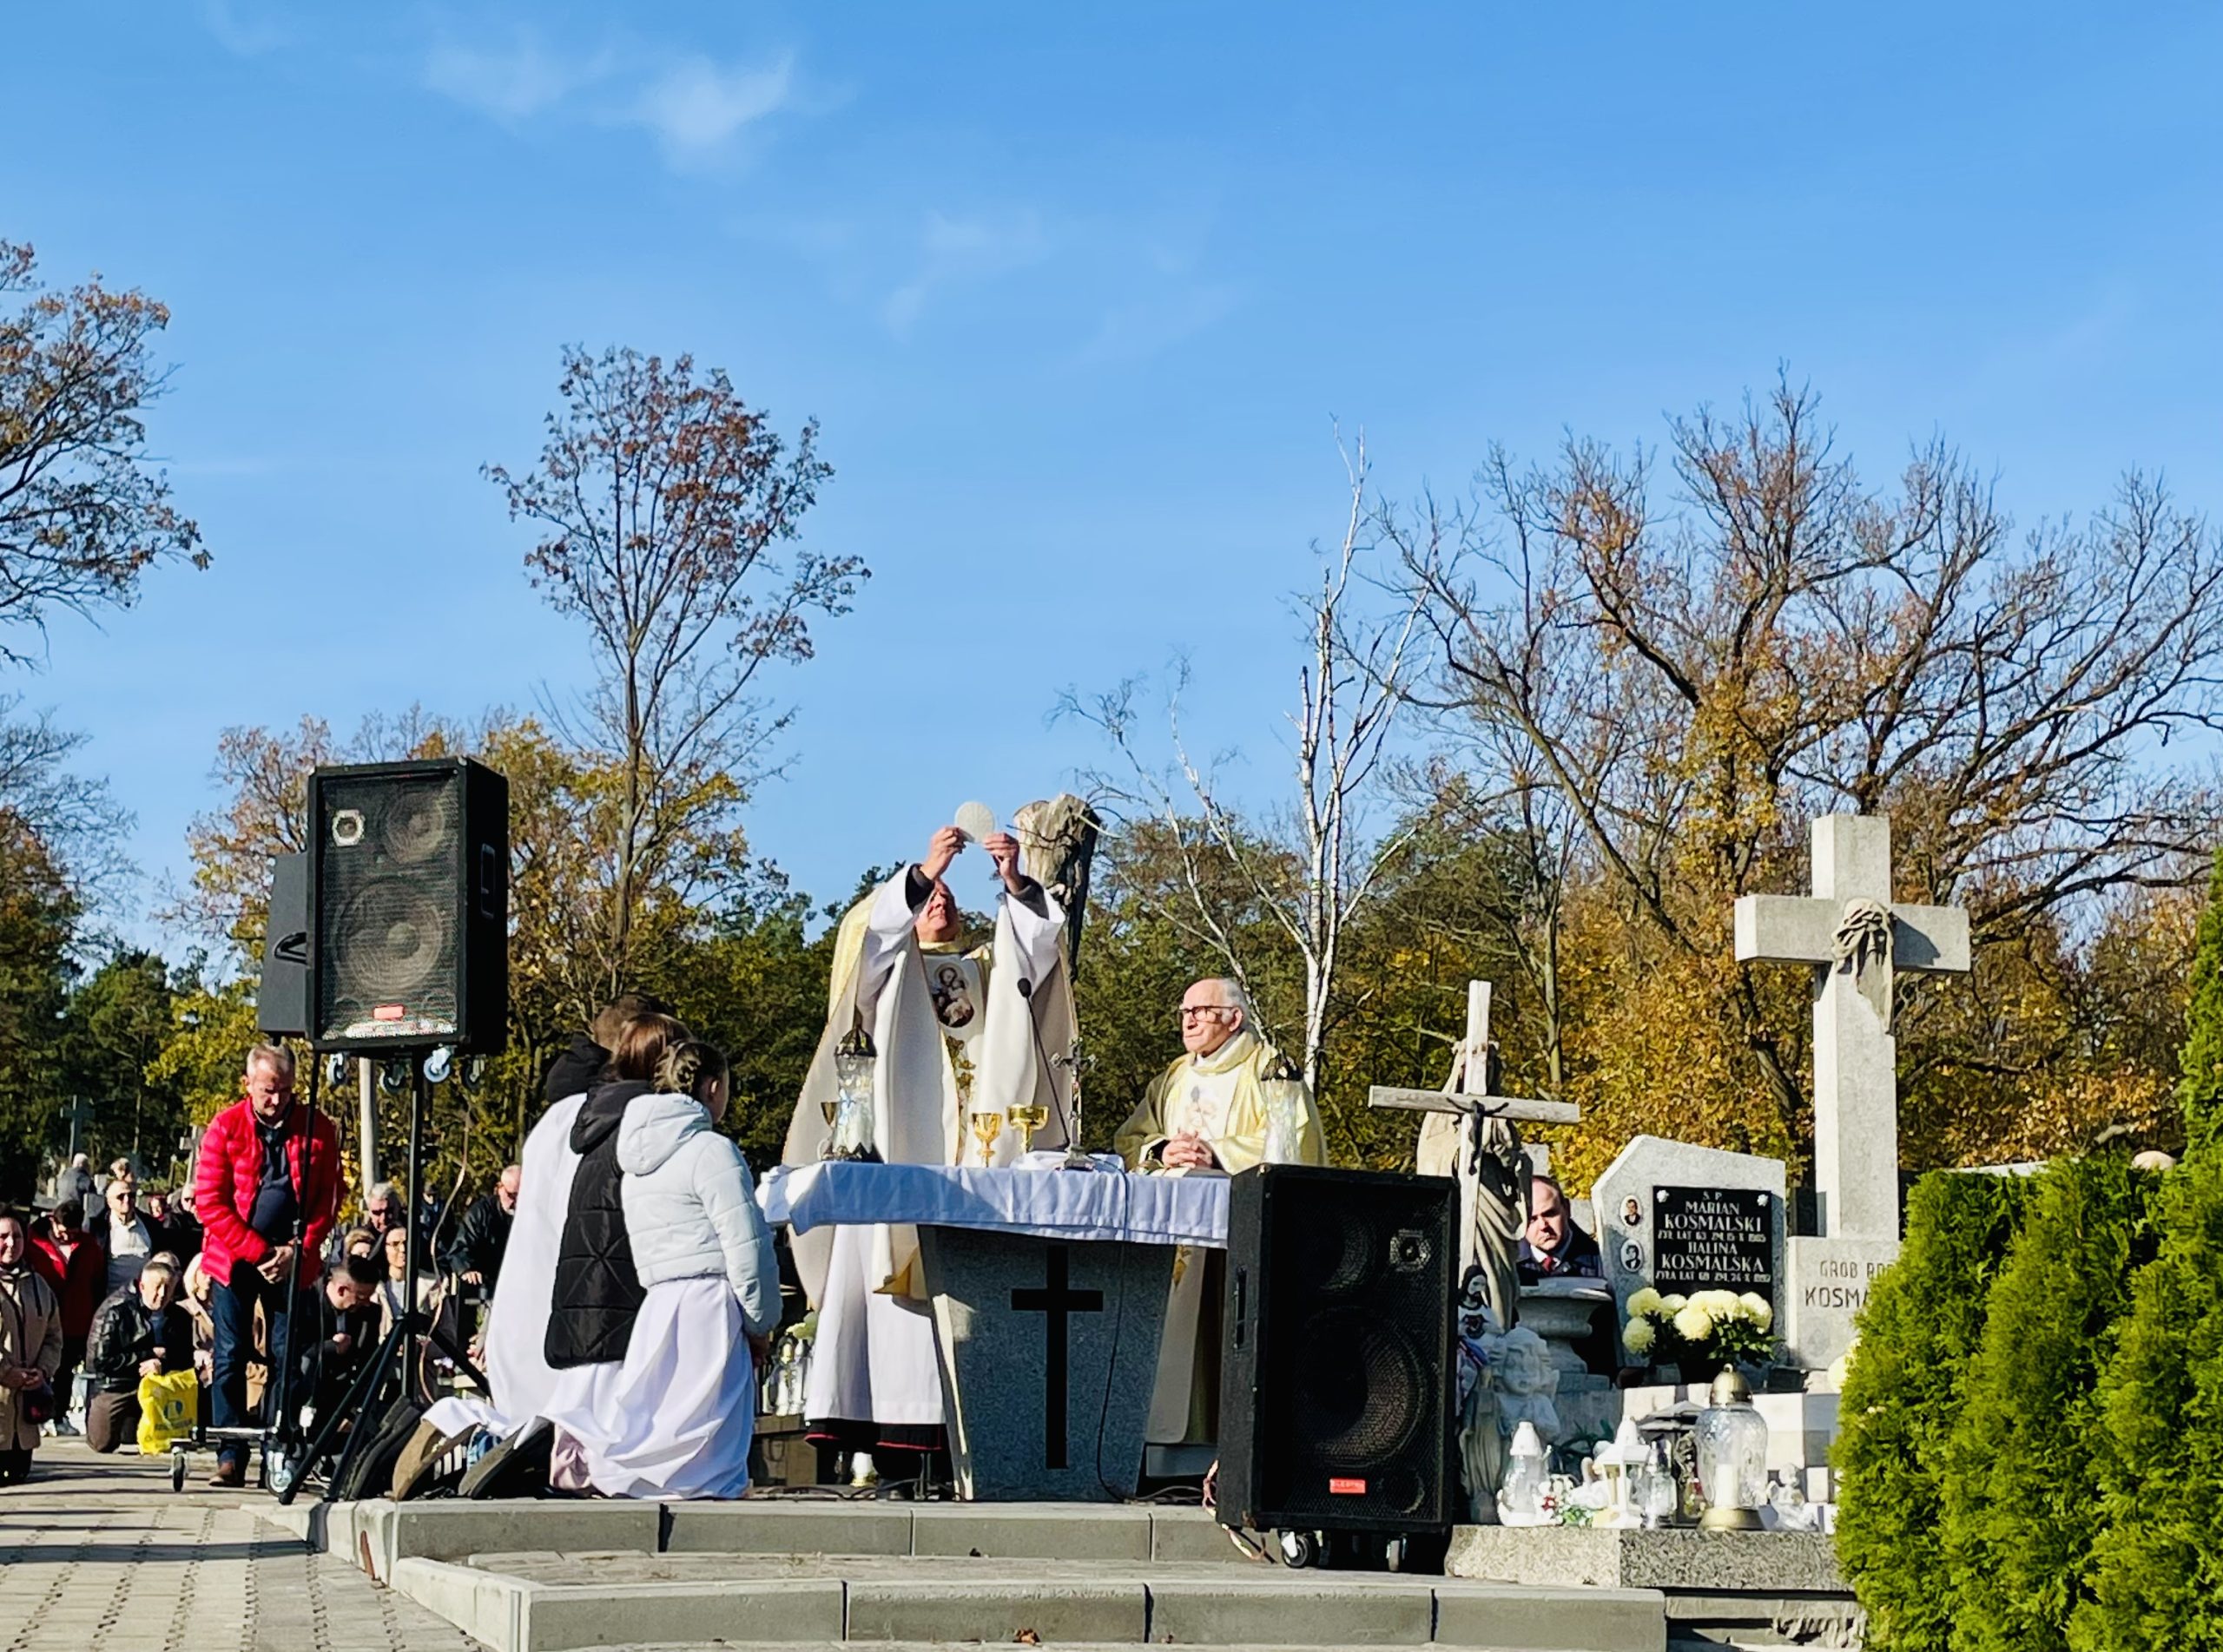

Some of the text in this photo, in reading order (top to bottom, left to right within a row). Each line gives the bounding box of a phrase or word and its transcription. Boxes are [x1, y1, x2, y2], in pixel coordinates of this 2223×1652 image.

[1685, 1201, 1739, 1215] MARIAN
[1665, 1214, 1761, 1232] KOSMALSKI
[1688, 1241, 1738, 1255] HALINA
[1662, 1253, 1765, 1273] KOSMALSKA
[1679, 1270, 1694, 1280] LAT
